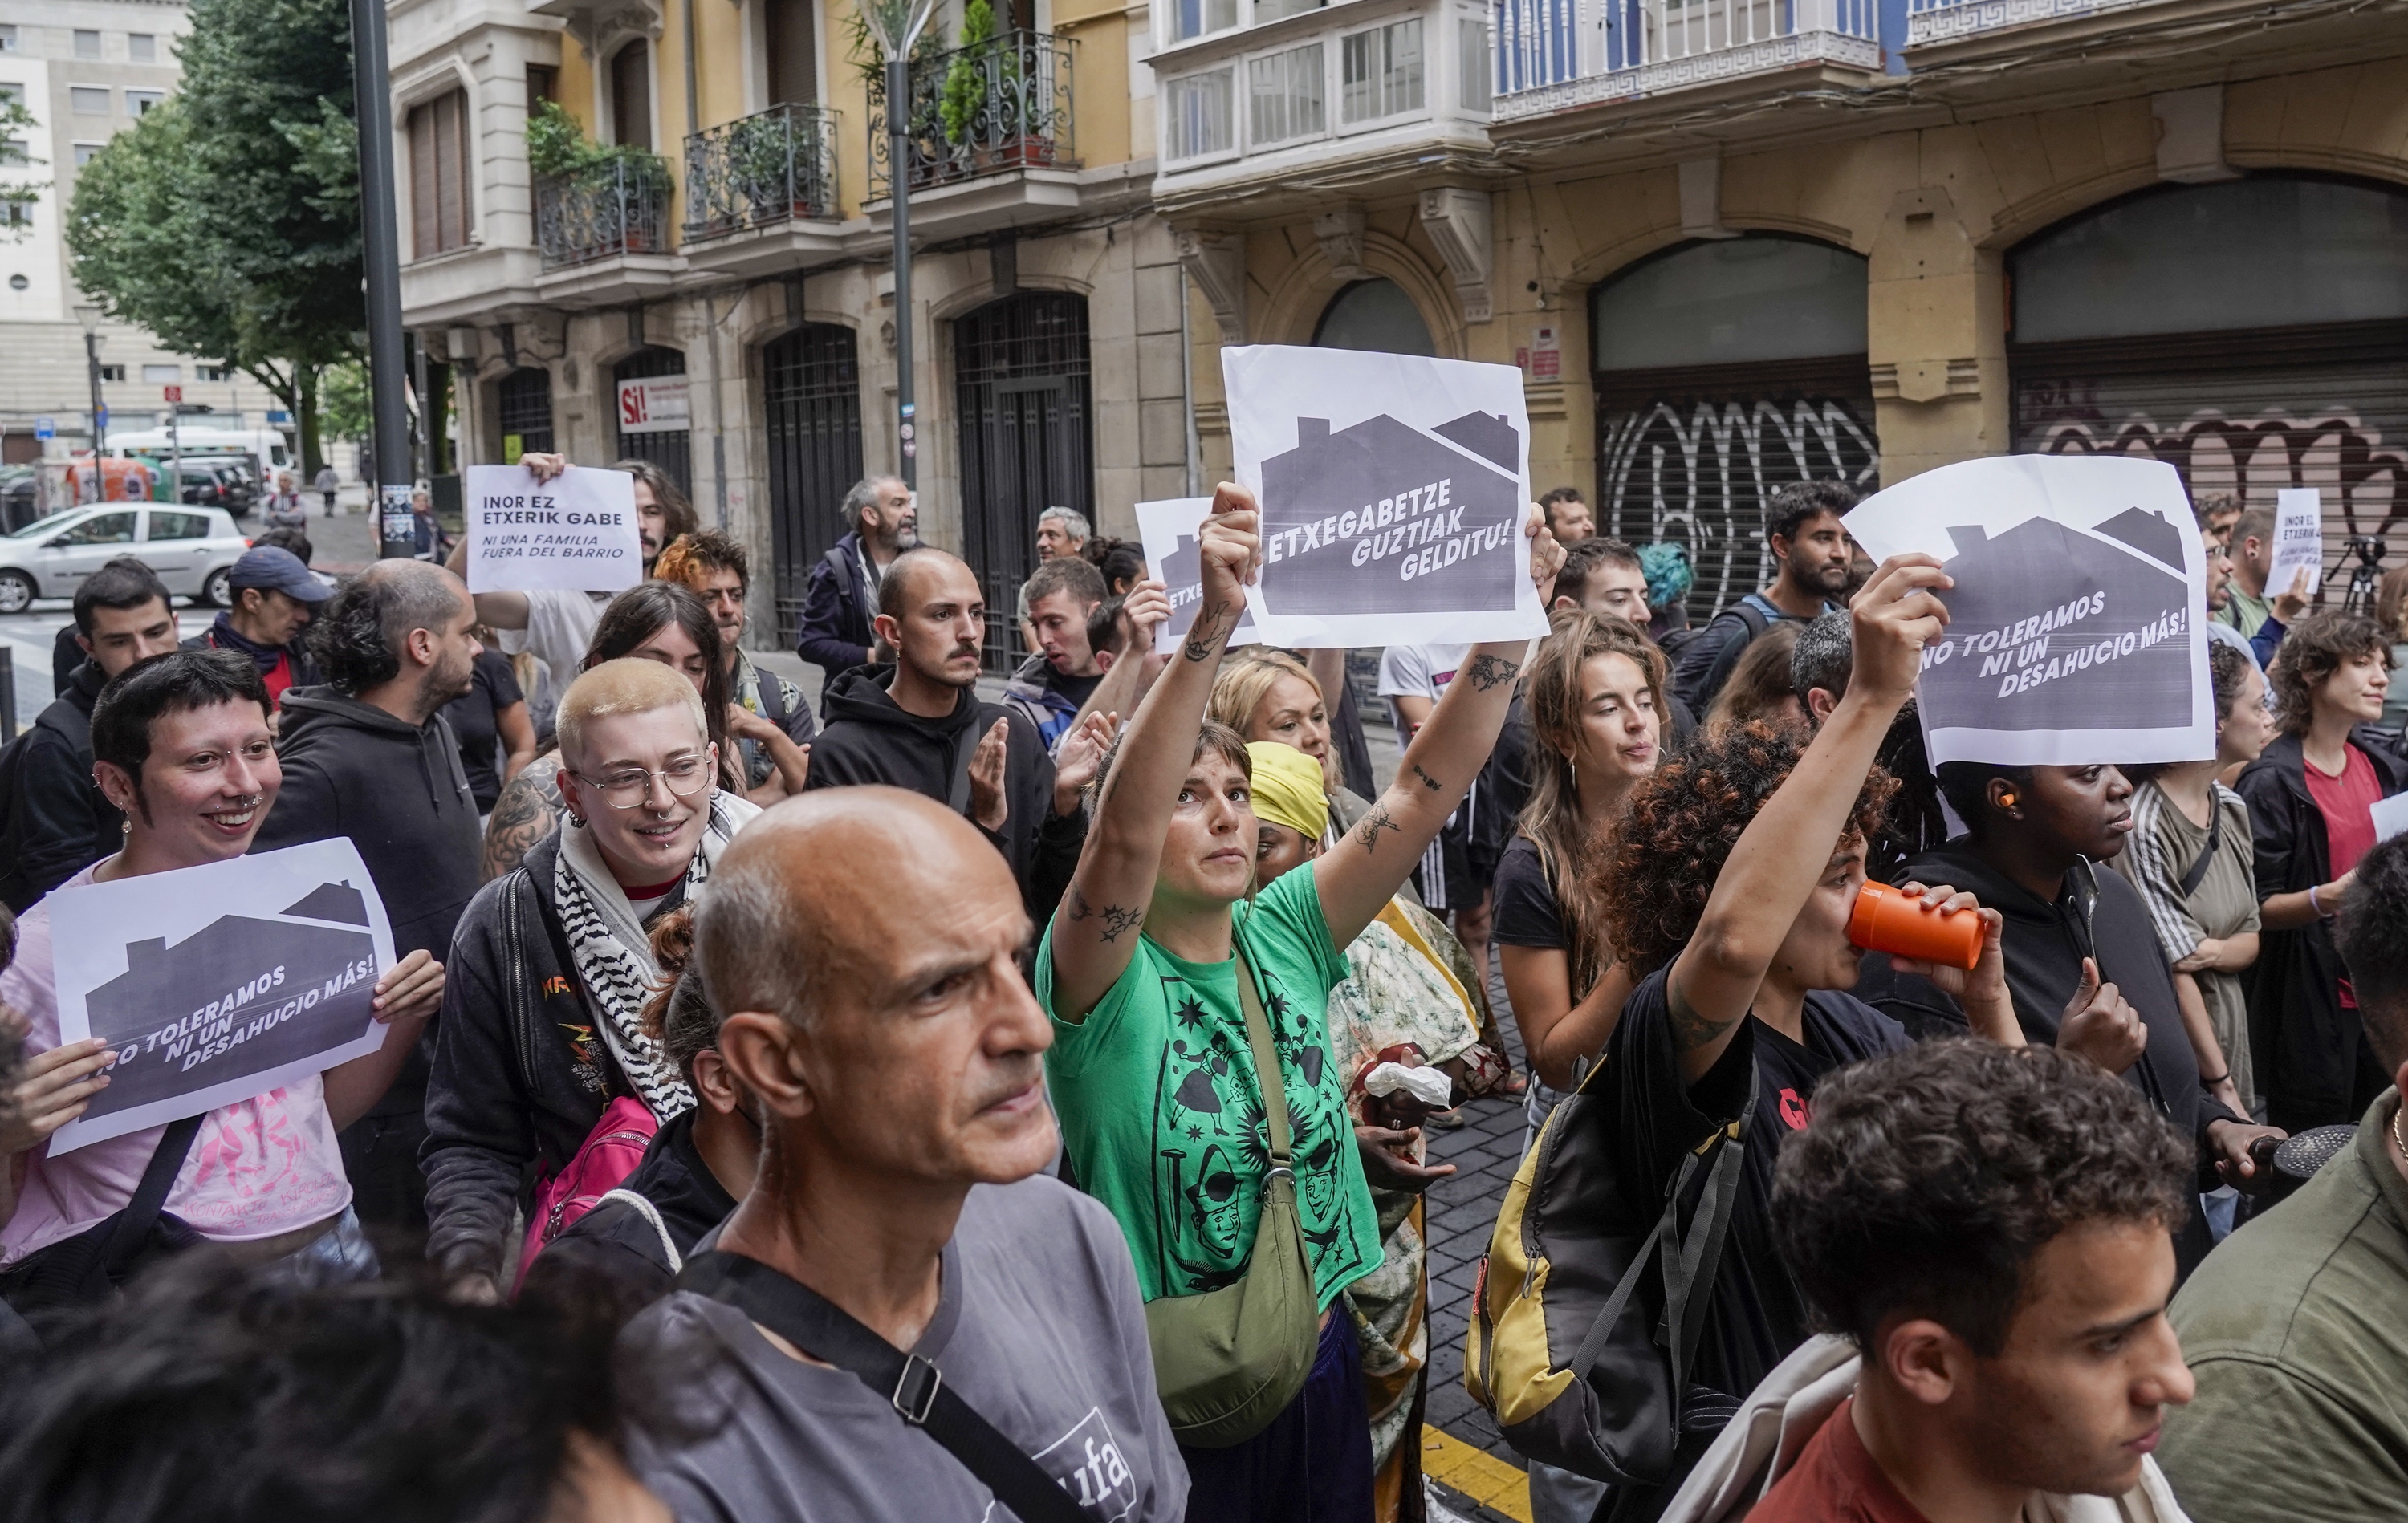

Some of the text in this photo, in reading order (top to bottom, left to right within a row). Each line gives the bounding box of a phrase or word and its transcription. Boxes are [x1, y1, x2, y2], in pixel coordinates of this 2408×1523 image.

[483, 496, 555, 510] INOR EZ
[483, 511, 623, 526] ETXERIK GABE
[1268, 478, 1451, 564] ETXEGABETZE
[482, 534, 598, 546] NI UNA FAMILIA
[482, 547, 624, 559] FUERA DEL BARRIO
[1351, 505, 1466, 567] GUZTIAK
[1400, 518, 1512, 582] GELDITU!
[1961, 591, 2105, 658] TOLERAMOS
[1997, 607, 2186, 699] DESAHUCIO MÁS!
[1979, 635, 2050, 678] NI UN
[146, 965, 286, 1054] TOLERAMOS
[164, 1013, 233, 1063] NI UN
[181, 953, 374, 1073] DESAHUCIO MÁS!
